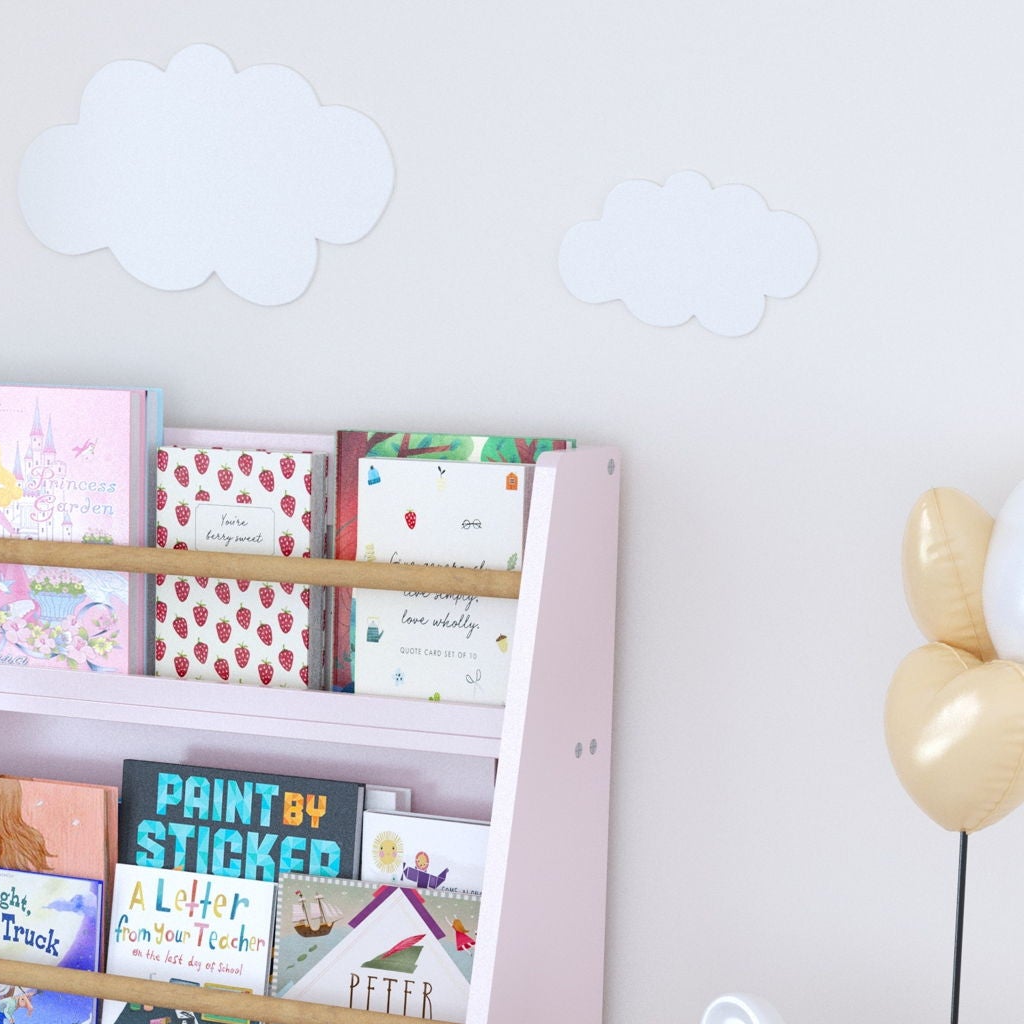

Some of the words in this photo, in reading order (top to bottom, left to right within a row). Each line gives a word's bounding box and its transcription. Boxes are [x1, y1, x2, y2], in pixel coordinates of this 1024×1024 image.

[27, 466, 117, 494] Princess
[30, 495, 114, 522] Garden
[220, 513, 249, 528] You're
[205, 531, 233, 547] berry
[233, 533, 264, 546] sweet
[401, 608, 428, 625] love
[432, 612, 480, 639] wholly.
[400, 646, 422, 655] QUOTE
[424, 649, 442, 657] CARD
[444, 650, 456, 658] SET
[457, 651, 467, 659] OF
[156, 772, 279, 827] PAINT
[283, 791, 327, 828] BY
[129, 881, 146, 911] A
[156, 878, 250, 921] Letter
[1, 913, 60, 957] Truck
[115, 914, 151, 945] from
[193, 922, 266, 953] Teacher
[132, 949, 143, 957] on
[146, 949, 160, 962] the
[164, 950, 184, 965] last
[188, 955, 202, 972] day
[205, 961, 215, 972] of
[349, 973, 433, 1020] PETER
